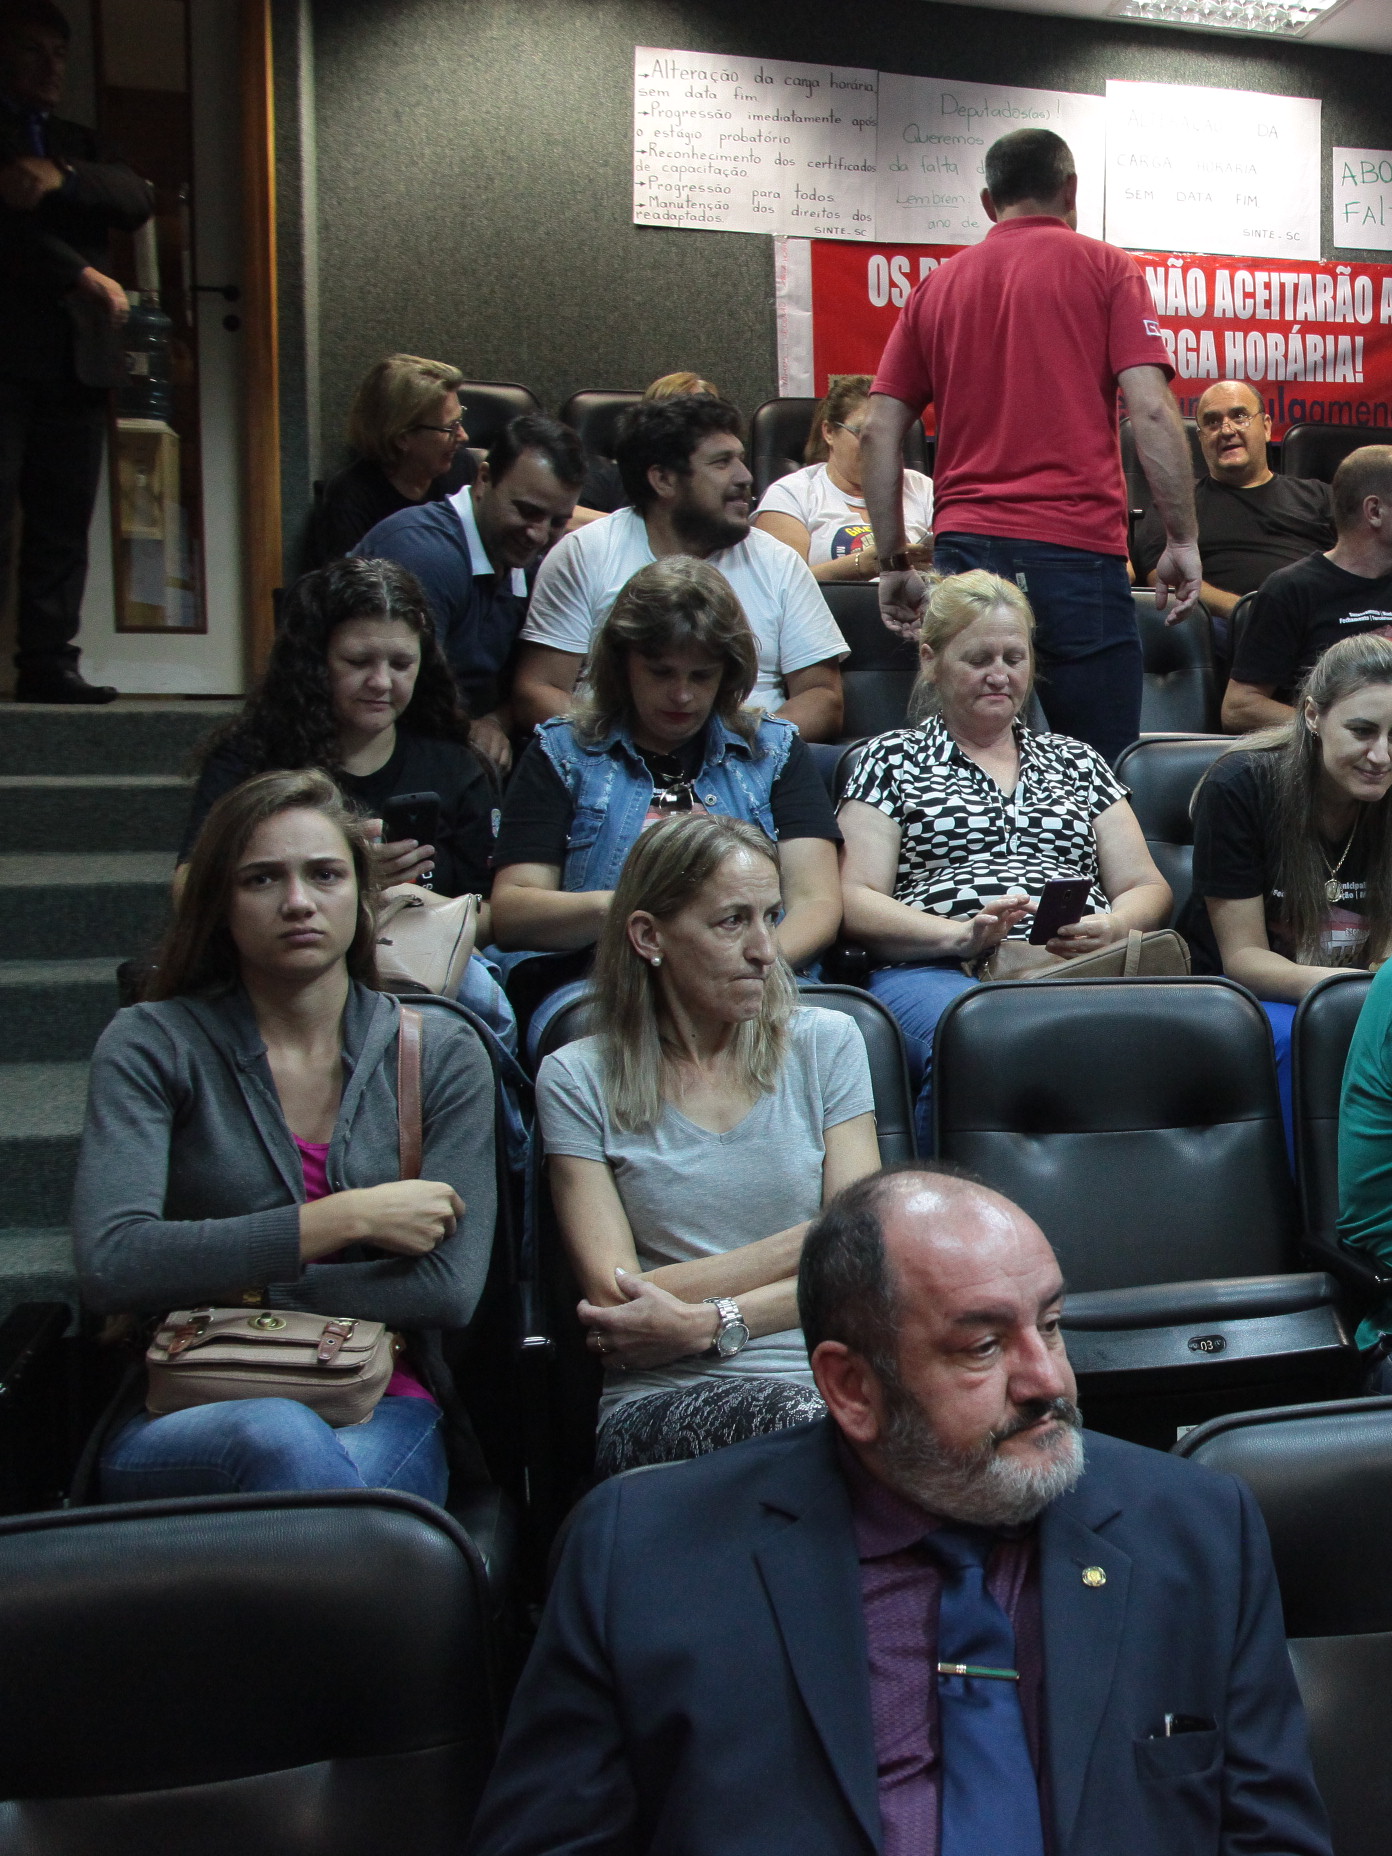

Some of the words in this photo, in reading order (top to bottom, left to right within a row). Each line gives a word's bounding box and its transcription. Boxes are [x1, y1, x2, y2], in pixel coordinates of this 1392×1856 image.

[652, 59, 738, 85] Alteração
[754, 66, 774, 86] da
[638, 88, 670, 97] sem
[684, 83, 717, 100] data
[650, 101, 732, 126] Progressão
[748, 109, 841, 125] imediatamente
[851, 115, 878, 132] após
[654, 124, 702, 145] estágio
[720, 129, 791, 148] probatório
[903, 123, 984, 146] Queremos
[1257, 124, 1278, 139] DA
[635, 161, 650, 172] de
[648, 142, 761, 165] Reconhecimento
[774, 152, 796, 167] dos
[807, 156, 877, 173] certificados
[889, 155, 909, 172] da
[921, 154, 959, 175] falta
[648, 175, 732, 198] Progressão
[752, 188, 781, 205] para
[794, 184, 835, 203] todos
[1125, 188, 1154, 200] SEM
[1176, 191, 1213, 202] DATA
[649, 194, 730, 211] Manutenção
[752, 201, 775, 214] dos
[791, 201, 841, 219] direitos
[852, 209, 872, 222] dos
[962, 219, 980, 228] de
[868, 254, 911, 308] OS
[1145, 257, 1206, 317] NÃO
[1213, 265, 1373, 324] ACEITARÃO
[1162, 329, 1219, 379] RGA
[1224, 325, 1364, 383] HORÁRIA!
